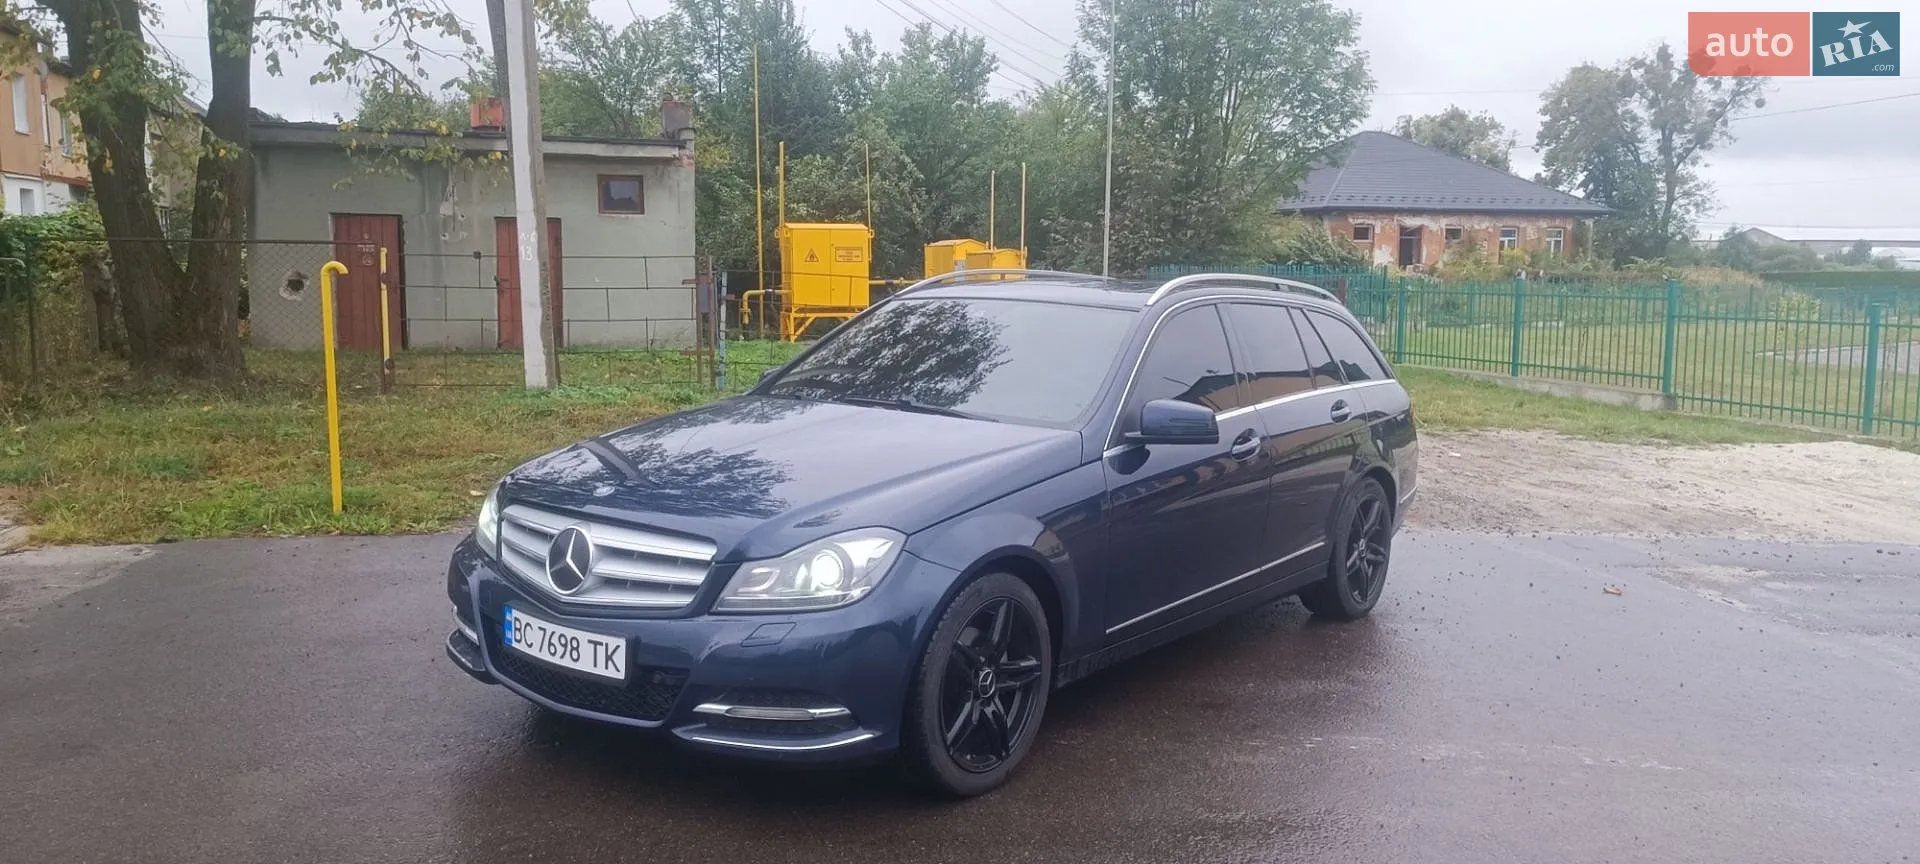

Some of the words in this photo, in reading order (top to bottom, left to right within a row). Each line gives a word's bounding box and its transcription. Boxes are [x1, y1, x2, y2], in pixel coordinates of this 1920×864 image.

[521, 245, 533, 261] 13
[513, 616, 534, 649] BC
[538, 626, 581, 663] 7698
[587, 639, 621, 673] TK
